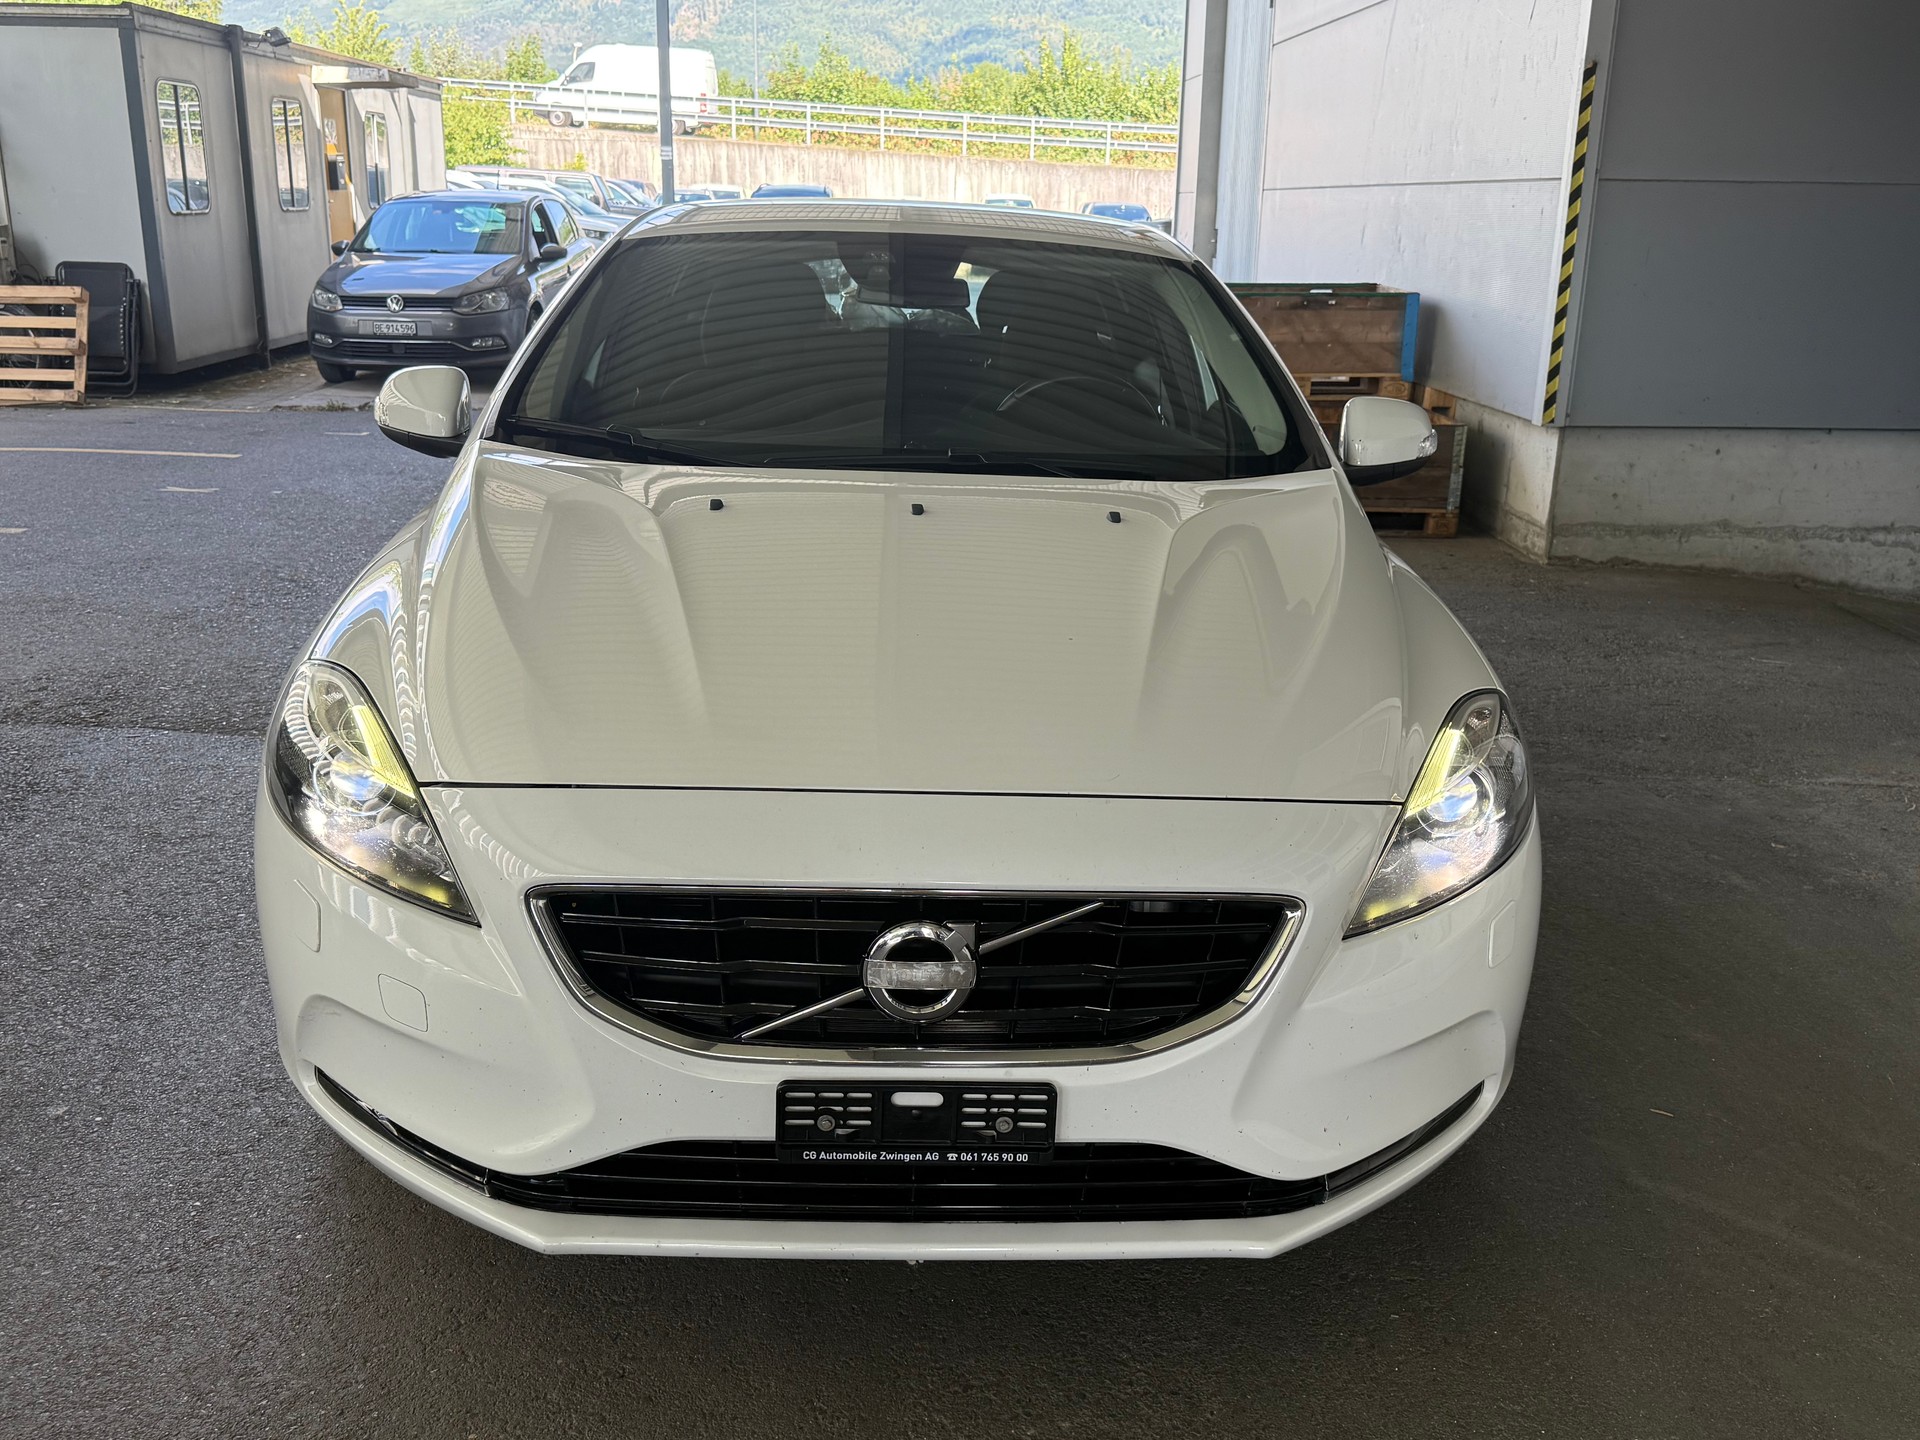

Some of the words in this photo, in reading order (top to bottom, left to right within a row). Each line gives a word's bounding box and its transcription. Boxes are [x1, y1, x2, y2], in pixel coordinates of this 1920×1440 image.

[803, 1151, 817, 1160] CG
[819, 1151, 878, 1160] Automobile
[880, 1151, 923, 1162] Zwingen
[924, 1152, 940, 1161] AG
[960, 1152, 978, 1161] 061
[981, 1152, 1000, 1161] 765
[1001, 1153, 1014, 1162] 90
[1016, 1153, 1029, 1162] 00
